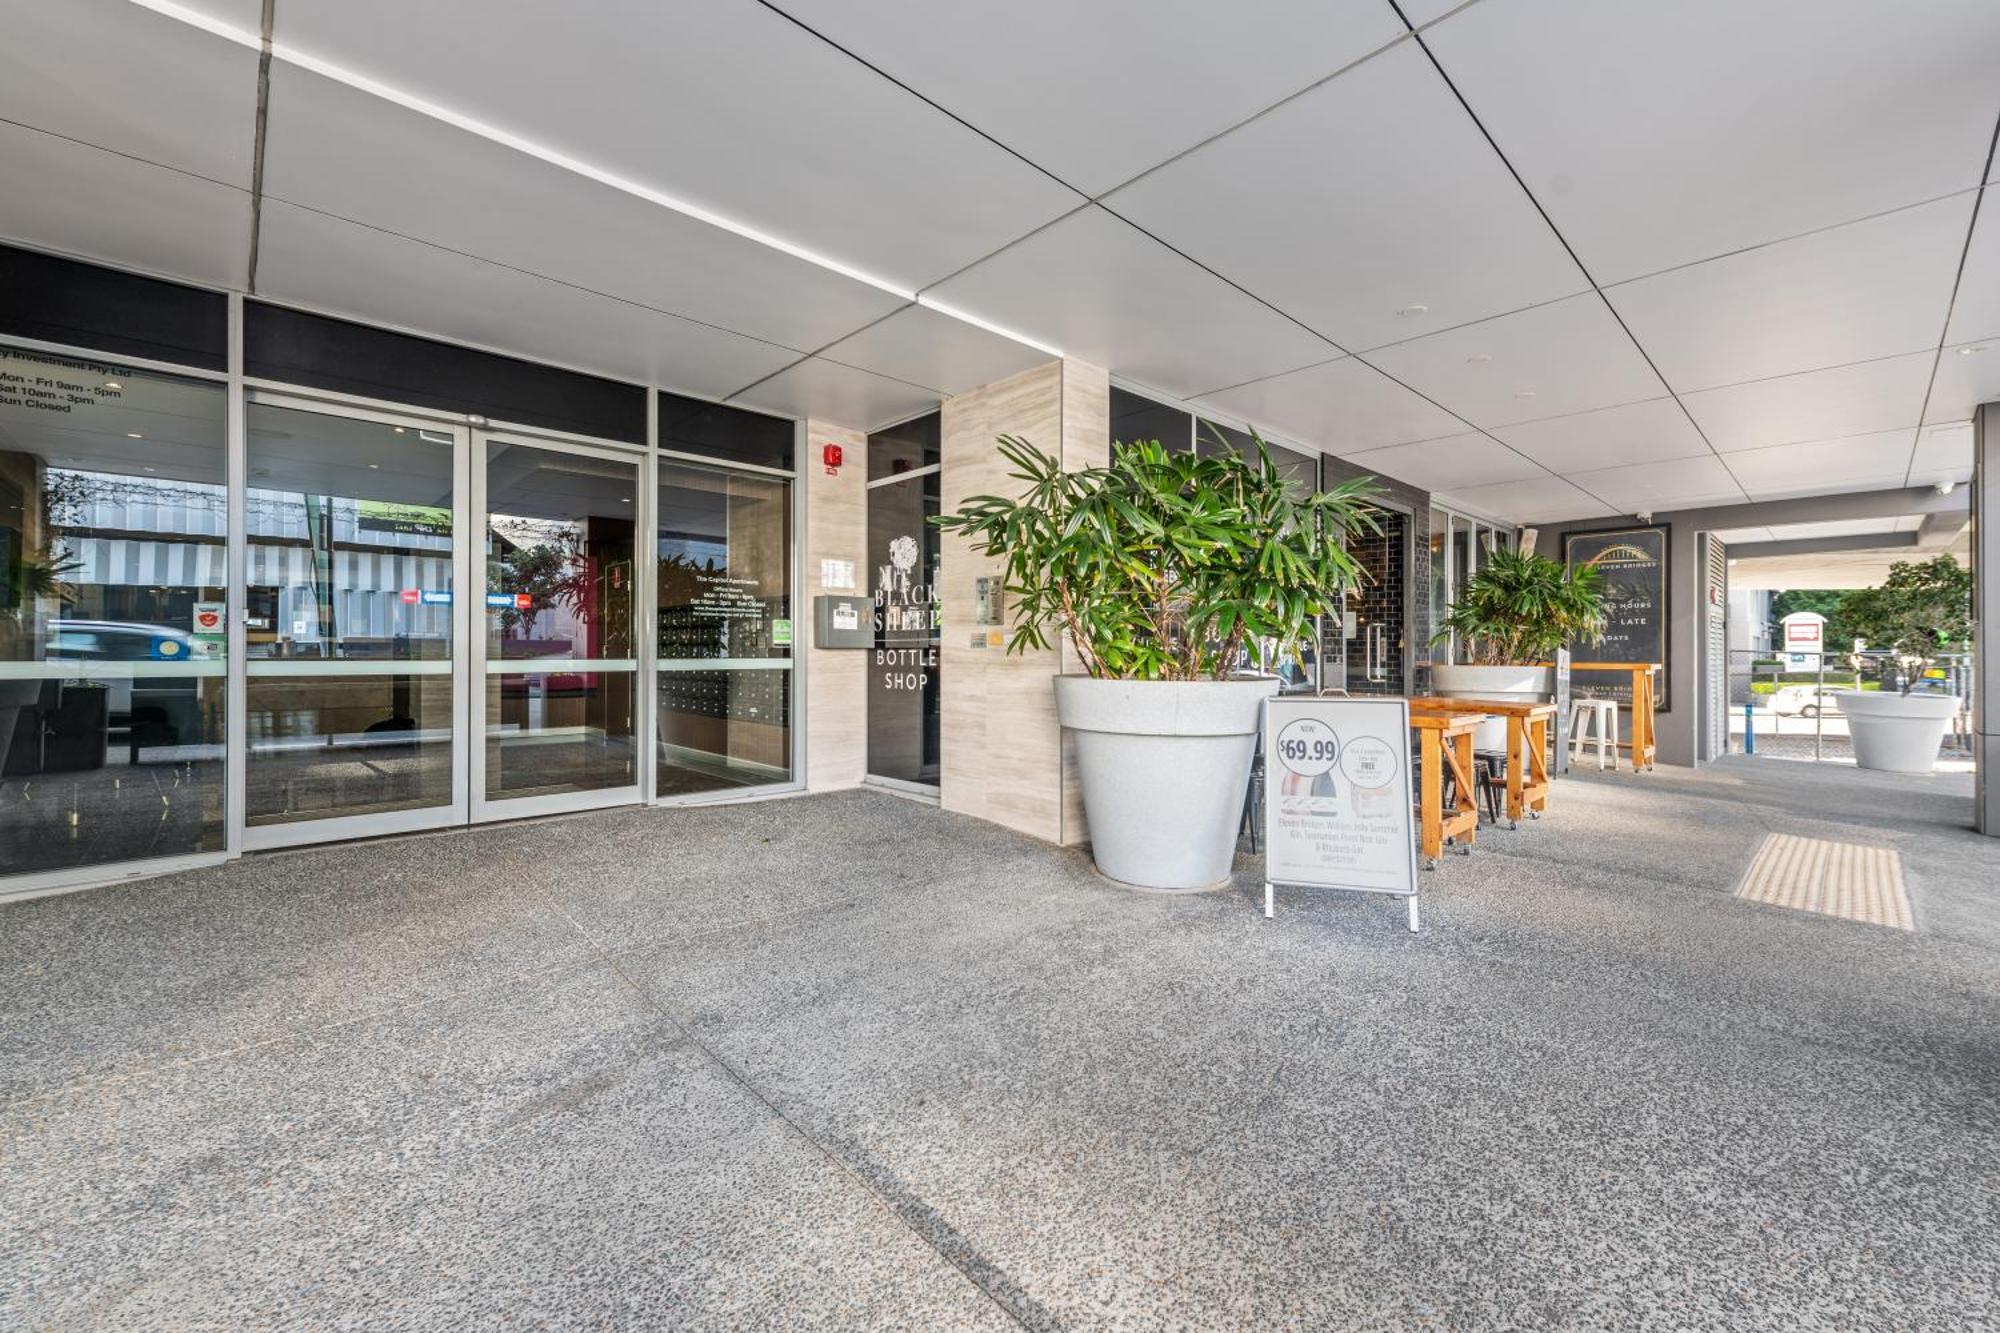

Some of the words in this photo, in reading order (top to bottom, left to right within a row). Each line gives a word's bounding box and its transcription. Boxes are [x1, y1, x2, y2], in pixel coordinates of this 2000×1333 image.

[13, 350, 87, 370] Investment
[89, 363, 108, 375] Pty
[112, 367, 131, 378] Ltd
[22, 386, 57, 400] 10am
[67, 394, 95, 406] 3pm
[36, 377, 53, 388] Fri
[56, 381, 84, 393] 9am
[94, 387, 121, 399] 5pm
[25, 399, 72, 414] Closed
[875, 584, 939, 607] BLACK
[1620, 602, 1652, 610] HOURS
[876, 649, 937, 666] BOTTLE
[885, 672, 928, 690] SHOP
[1280, 739, 1336, 761] $69.99
